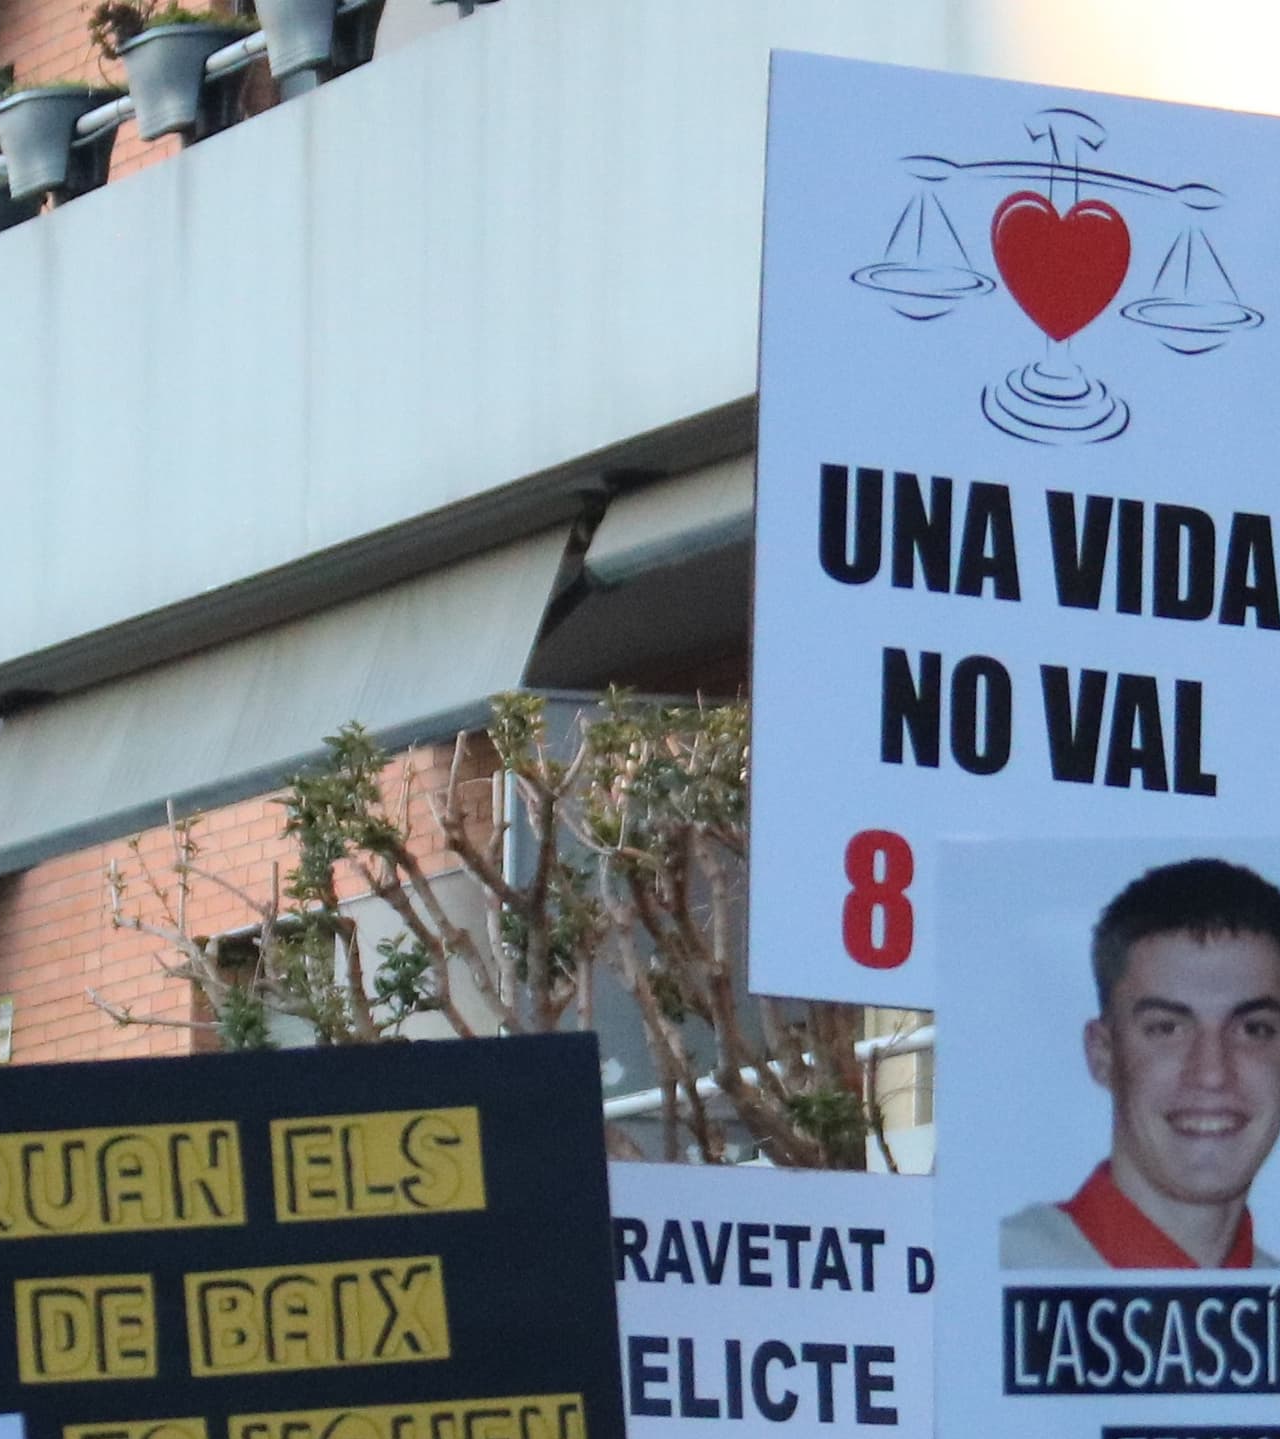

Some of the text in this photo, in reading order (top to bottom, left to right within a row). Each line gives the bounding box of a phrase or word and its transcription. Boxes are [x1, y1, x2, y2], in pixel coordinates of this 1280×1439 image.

[819, 463, 1022, 602] UNA
[879, 646, 1217, 797] NO VAL
[841, 828, 915, 969] 8
[284, 1114, 466, 1215] ELS
[611, 1216, 935, 1294] RAVETAT D
[31, 1262, 433, 1375] DE BAIX
[1013, 1286, 1280, 1387] L'ASSASSÍ
[627, 1335, 898, 1426] ELICTE
